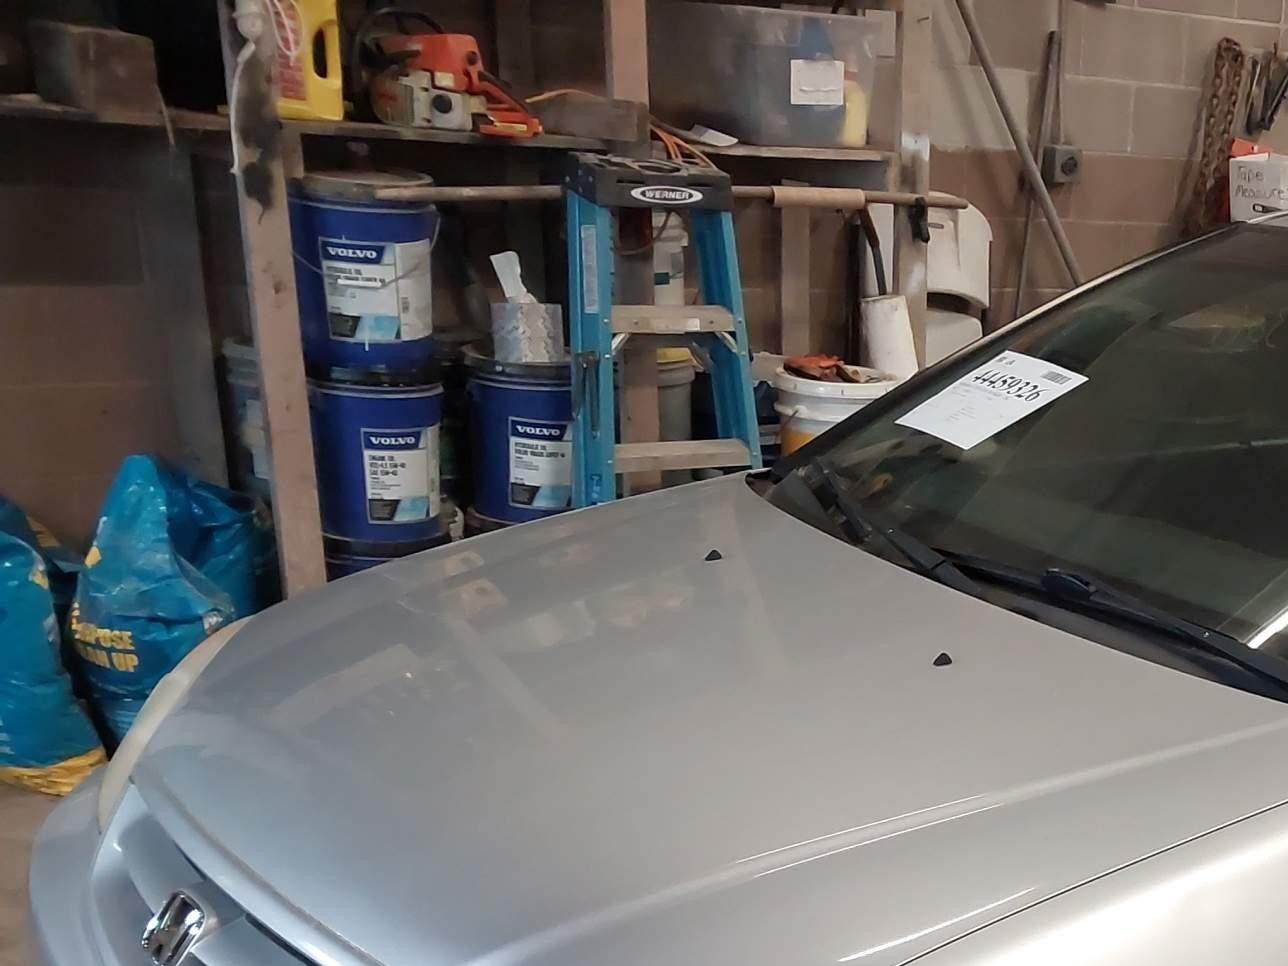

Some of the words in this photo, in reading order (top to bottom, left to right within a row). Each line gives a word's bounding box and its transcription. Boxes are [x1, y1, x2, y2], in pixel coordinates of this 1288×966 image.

[1237, 165, 1264, 182] Tape
[644, 189, 689, 200] WERNER
[326, 246, 377, 259] VOLVO
[971, 368, 1048, 402] 44459326
[515, 425, 561, 436] VOLVO
[369, 436, 416, 445] VOLVO
[112, 652, 139, 672] UP
